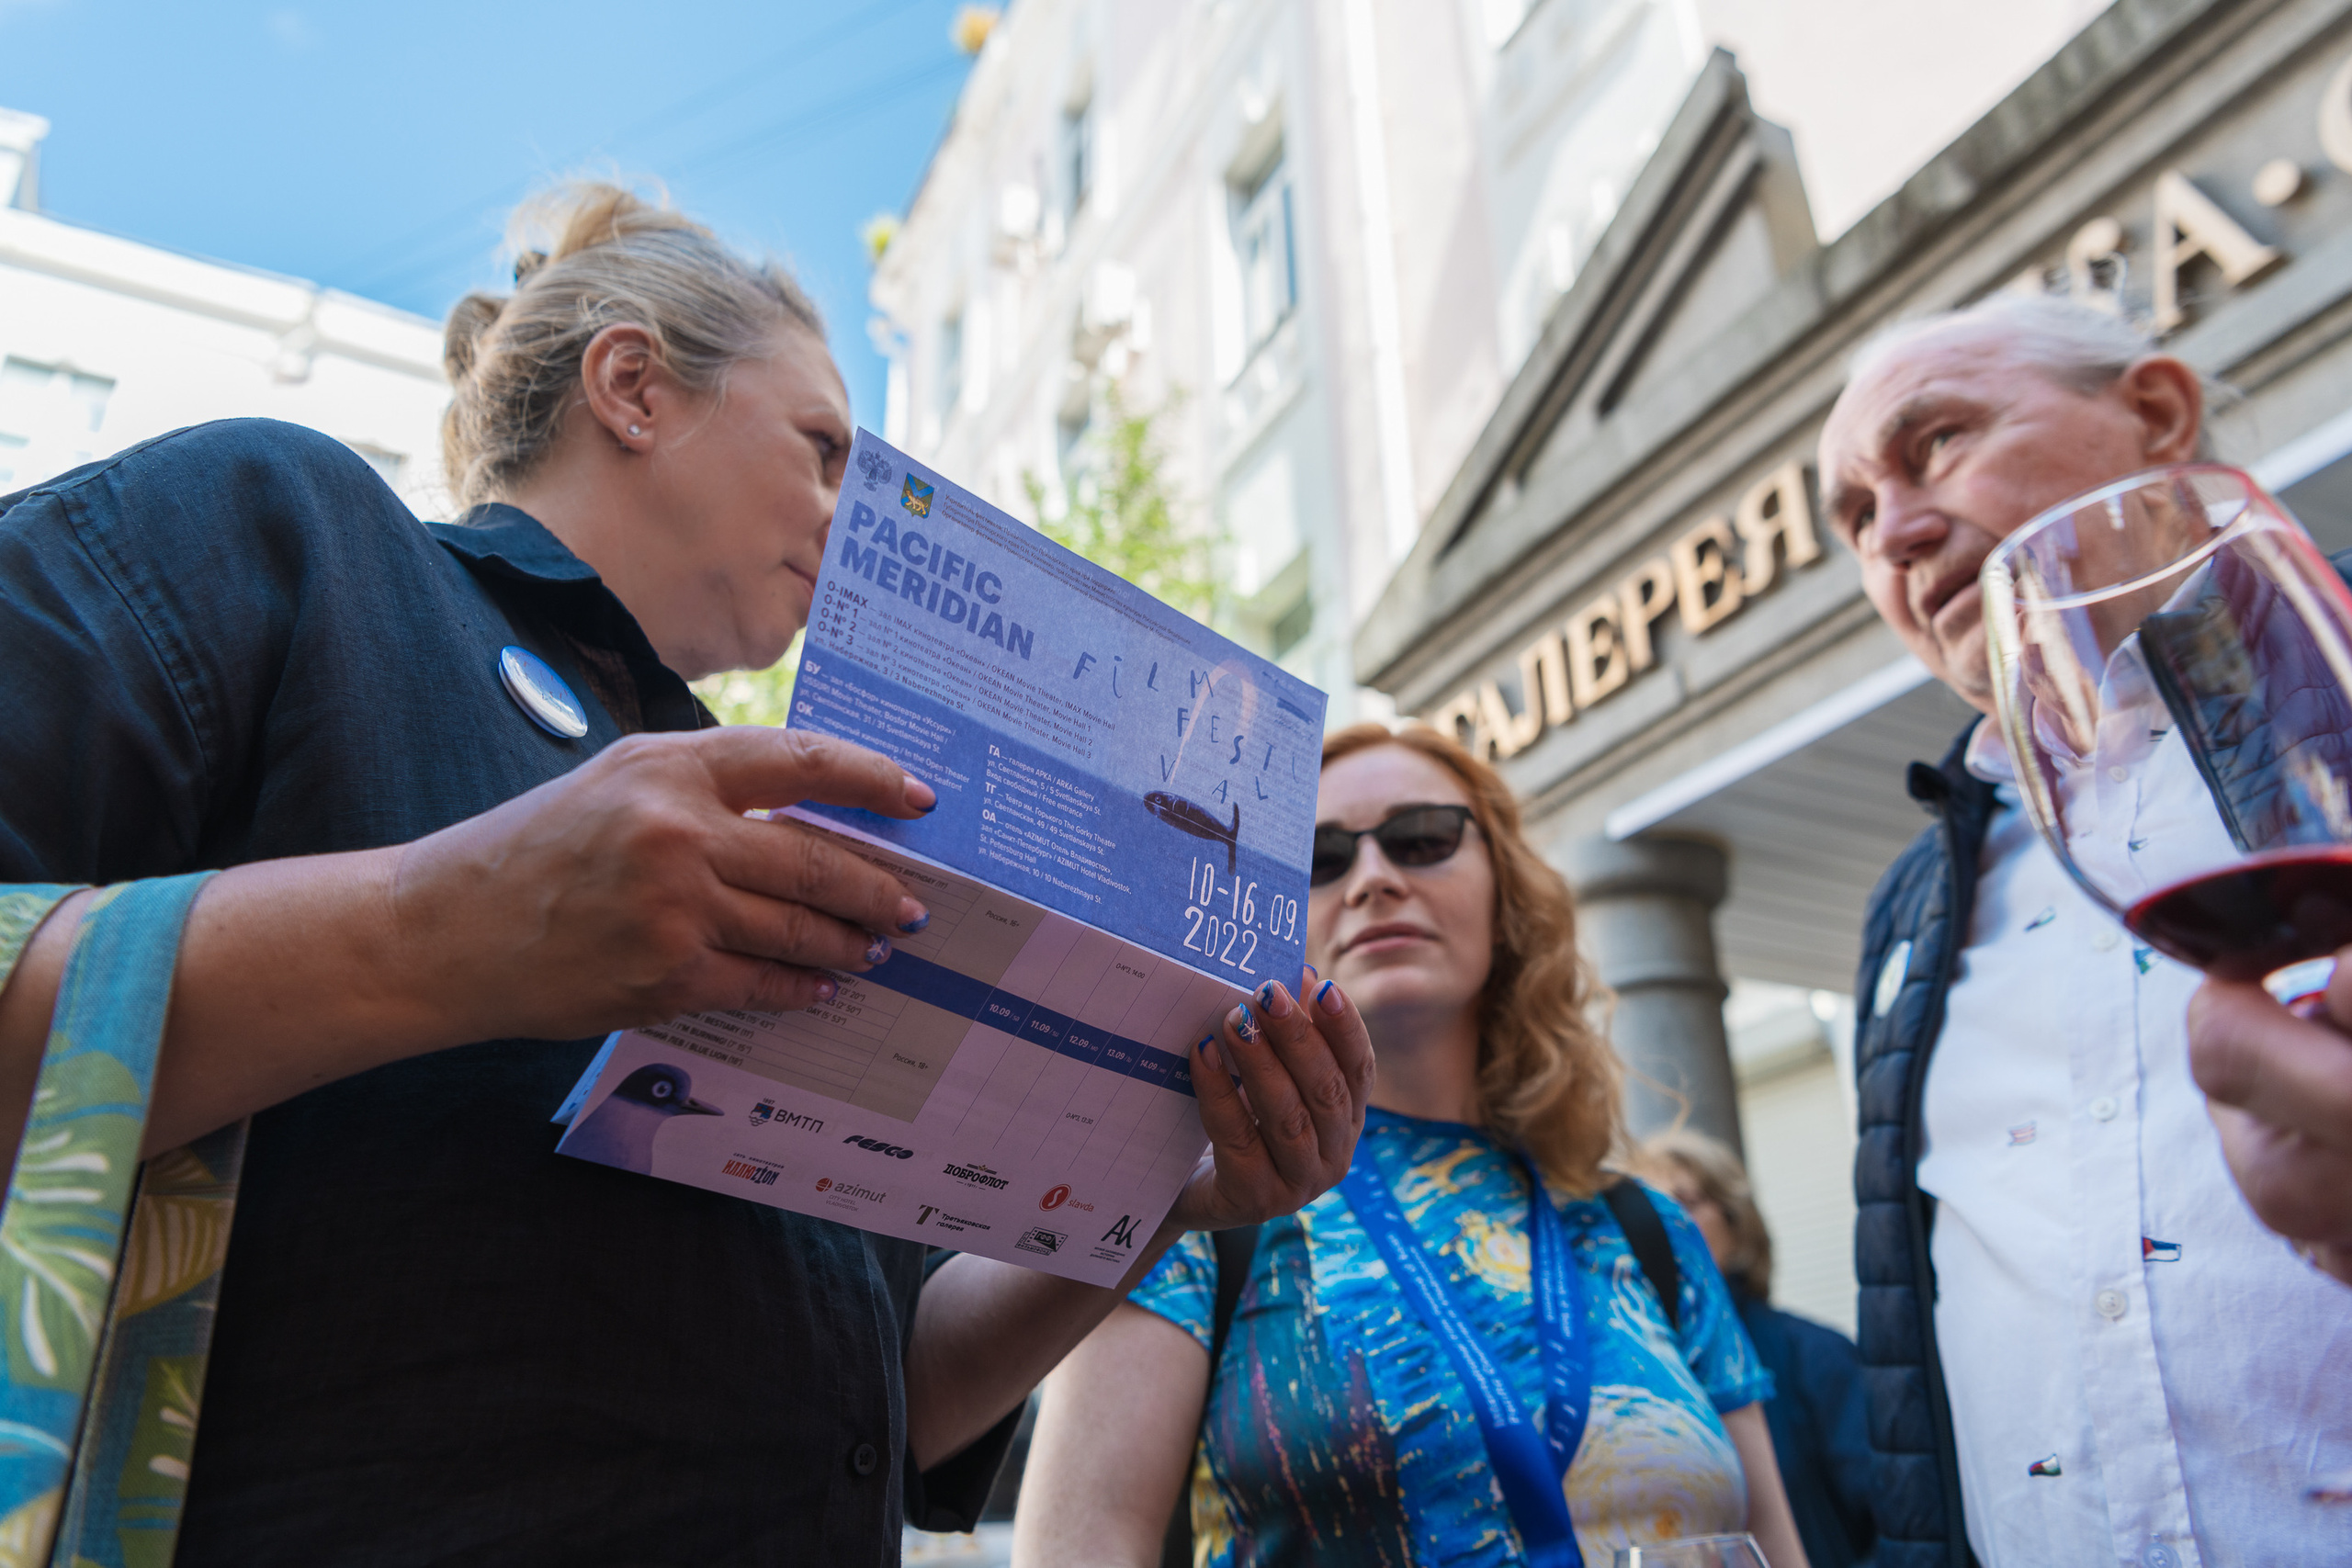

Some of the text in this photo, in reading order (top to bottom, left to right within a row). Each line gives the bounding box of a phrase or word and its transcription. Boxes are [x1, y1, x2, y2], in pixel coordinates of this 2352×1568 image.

[847, 500, 1002, 605] PACIFIC
[839, 536, 1035, 661] MERIDIAN
[1433, 462, 1821, 765] ГАЛЕРЕЯ
[828, 640, 966, 711] Набережная, Naberezhnaya St.
[893, 615, 912, 631] IMAX
[913, 627, 955, 653] кинотеатра
[956, 647, 985, 667] «Океан»
[991, 664, 1014, 682] OKEAN
[1016, 677, 1035, 692] Movie
[1037, 687, 1063, 706] Theater,
[1065, 701, 1080, 714] IMAX
[1082, 709, 1101, 724] Movie
[1102, 719, 1114, 730] Hall
[899, 635, 941, 660] кинотеатра
[942, 654, 971, 674] «Океан»
[978, 671, 1001, 689] OKEAN
[1003, 683, 1023, 699] Movie
[1024, 694, 1050, 714] Theater,
[1052, 708, 1071, 723] Movie
[1073, 718, 1085, 729] Hall
[804, 660, 820, 676] БУ
[880, 698, 921, 722] кинотеатра
[922, 715, 952, 736] «Уссури»
[898, 662, 940, 689] кинотеатра
[942, 682, 970, 702] «Океан»
[977, 699, 1001, 716] OKEAN
[1002, 711, 1022, 726] Movie
[1023, 721, 1050, 740] Theater,
[1052, 735, 1070, 750] Movie
[1072, 744, 1085, 756] Hall
[899, 649, 941, 675] кинотеатра
[943, 669, 972, 688] «Океан»
[978, 685, 1001, 703] OKEAN
[1003, 698, 1023, 713] Movie
[1025, 708, 1052, 728] Theater,
[1053, 722, 1072, 737] Movie
[1074, 731, 1086, 743] Hall
[831, 687, 944, 742] Movie Theater, Bosfor Movie Hall
[886, 723, 931, 750] Svetlanskaya
[912, 752, 924, 764] the
[924, 758, 944, 773] Open
[944, 766, 969, 784] Theater
[989, 744, 1094, 802] ГА галерея АРКА ARKA Gallery
[933, 773, 962, 792] Seafront
[986, 768, 1082, 818] Вход свободный Free entrance
[998, 762, 1102, 816] Светланская, Svetlanskaya St.
[984, 782, 1115, 849] ТГ Театр Горького The Gorky Theatre
[993, 800, 1035, 826] Светланская,
[1036, 818, 1045, 829] 49
[1049, 825, 1057, 834] 49
[1057, 829, 1096, 852] Svetlanskaya
[979, 833, 1036, 863] St. Petersburg Hall
[981, 808, 1113, 876] ОА отель «AZIMUT Отель Владивосток»,
[981, 824, 1132, 896] зал «Санкт-Петербург» AZIMUT Hotel Vladivostok,
[901, 868, 936, 885] BIRTHDAY
[989, 849, 1102, 904] Набережная, Naberezhnaya St.
[983, 909, 1021, 928] Россия, 16+
[1183, 906, 1258, 976] 2022
[1130, 968, 1147, 979] 14:00
[806, 1005, 822, 1016] DAY
[987, 1003, 1012, 1017] 10.09
[703, 1016, 741, 1033] BESTIARY
[1028, 1020, 1051, 1032] 11.09
[666, 1035, 686, 1046] ЛЕВ
[687, 1043, 711, 1055] BLUE
[708, 1049, 729, 1061] LION
[1067, 1034, 1090, 1047] 12.09
[1104, 1048, 1125, 1060] 13.09
[891, 1053, 930, 1070] Россия, 18+
[1137, 1059, 1159, 1071] 14.09
[772, 1109, 825, 1133] ВМТП
[1080, 1116, 1094, 1124] 13:30
[841, 1133, 916, 1161] FESCO
[941, 1163, 1010, 1190] ДОБРОФЛОТ
[832, 1179, 888, 1203] azimut
[839, 1197, 857, 1205] HOTEL
[824, 1200, 859, 1212] VLADIVOSTOK
[1067, 1198, 1095, 1212] slavda
[934, 1221, 964, 1233] галерея
[939, 1213, 991, 1231] Третьяковская
